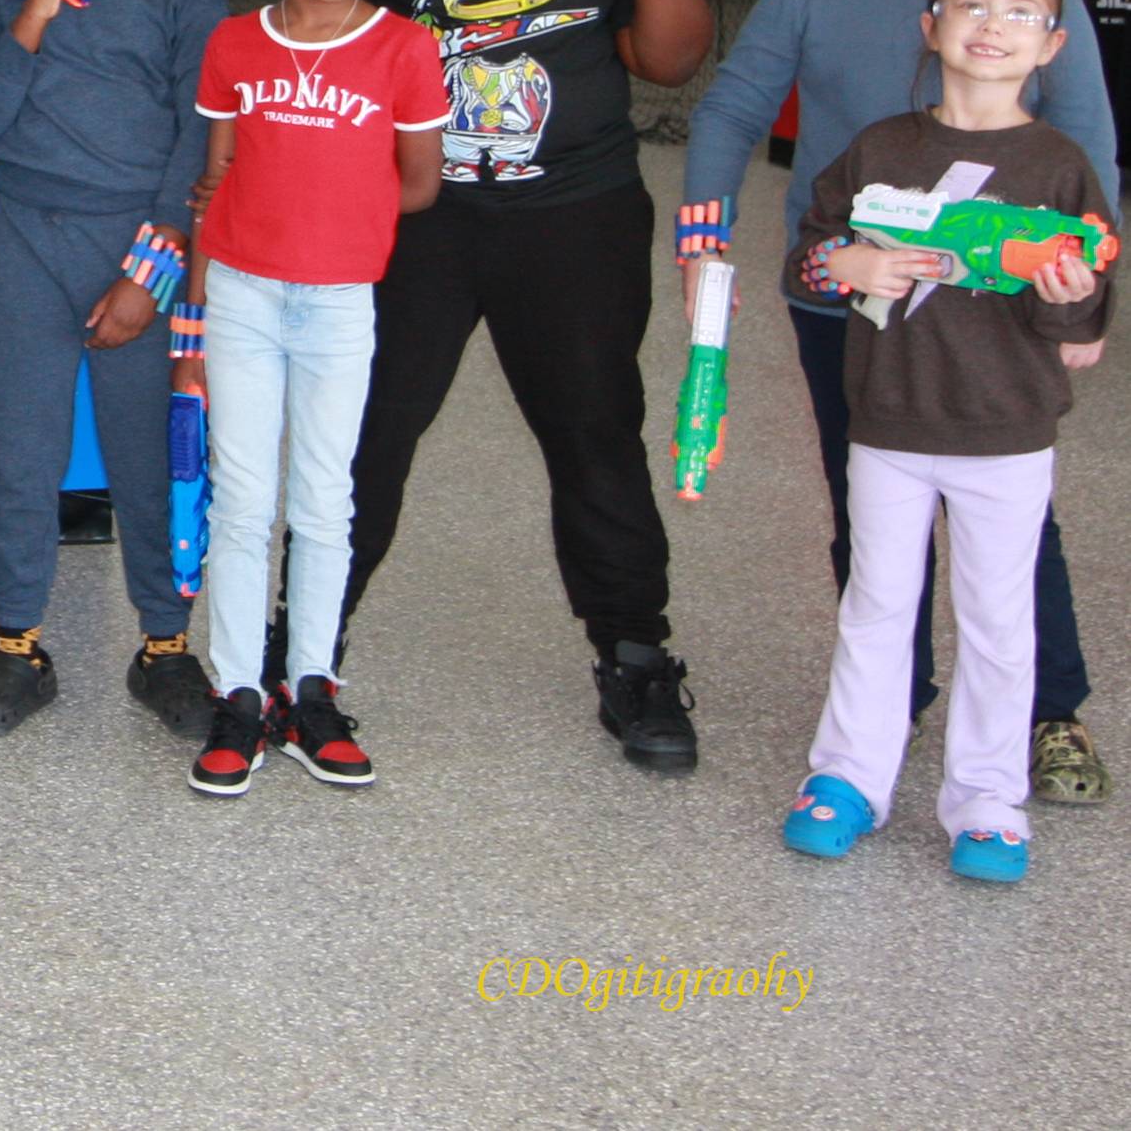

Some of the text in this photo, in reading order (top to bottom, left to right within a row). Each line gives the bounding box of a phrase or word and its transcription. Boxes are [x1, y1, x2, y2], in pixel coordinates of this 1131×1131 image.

[233, 72, 381, 127] OLD NAVY
[263, 110, 336, 129] TRADEMARK
